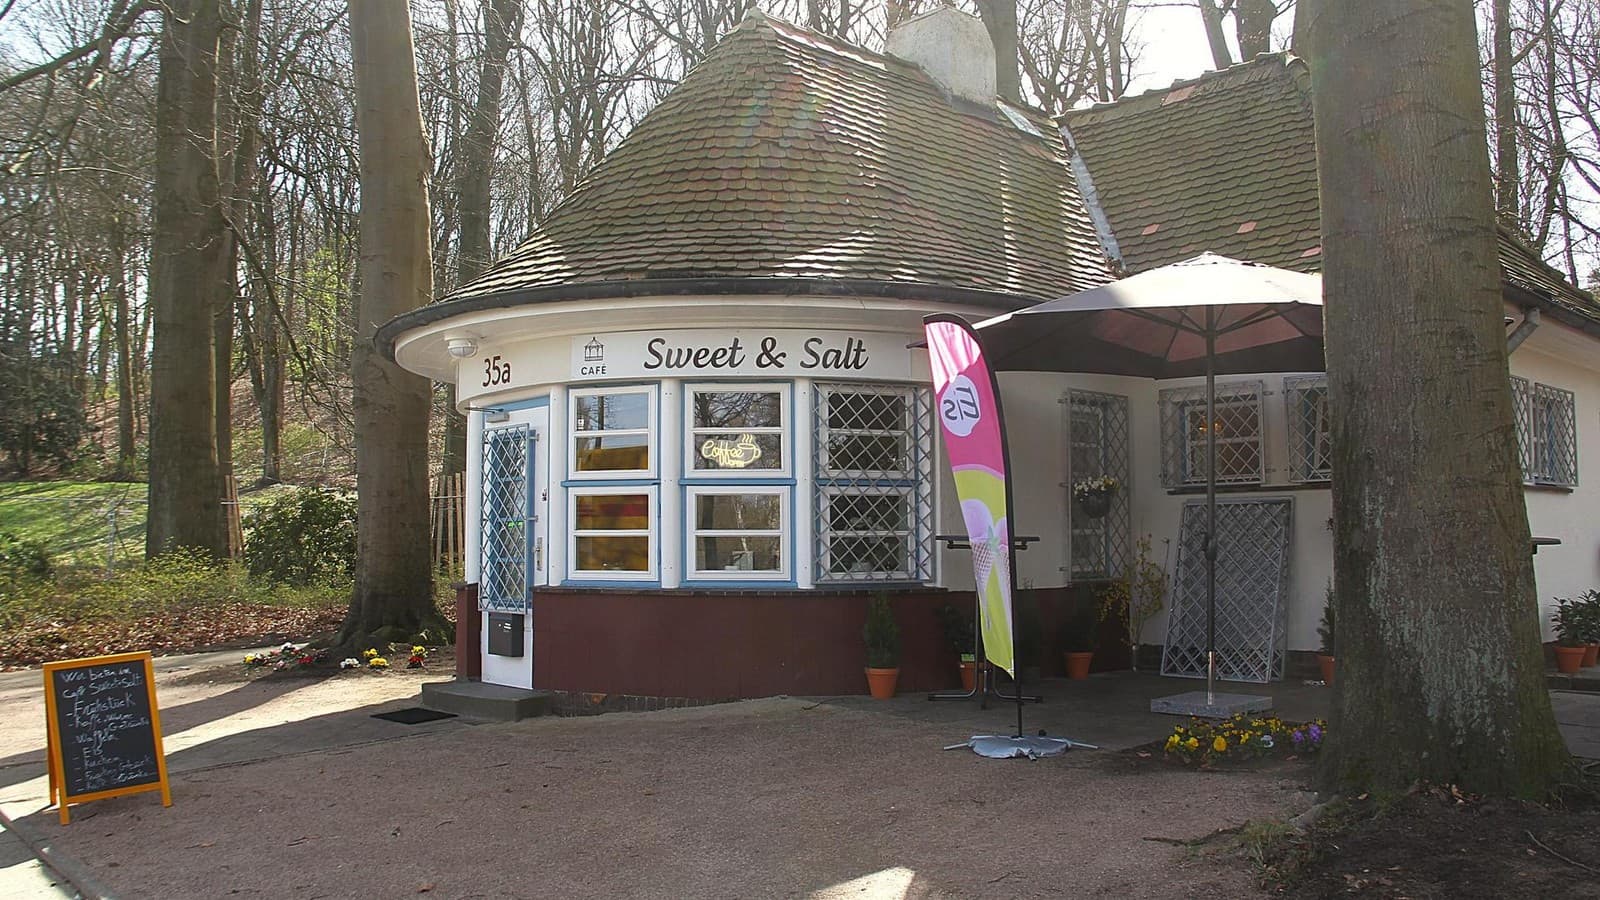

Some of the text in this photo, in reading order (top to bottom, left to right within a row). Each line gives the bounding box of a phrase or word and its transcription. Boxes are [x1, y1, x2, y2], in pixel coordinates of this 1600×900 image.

[643, 336, 870, 370] Sweet & Salt
[482, 355, 512, 387] 35a
[580, 363, 607, 376] CAFÉ
[701, 439, 745, 466] Coffee
